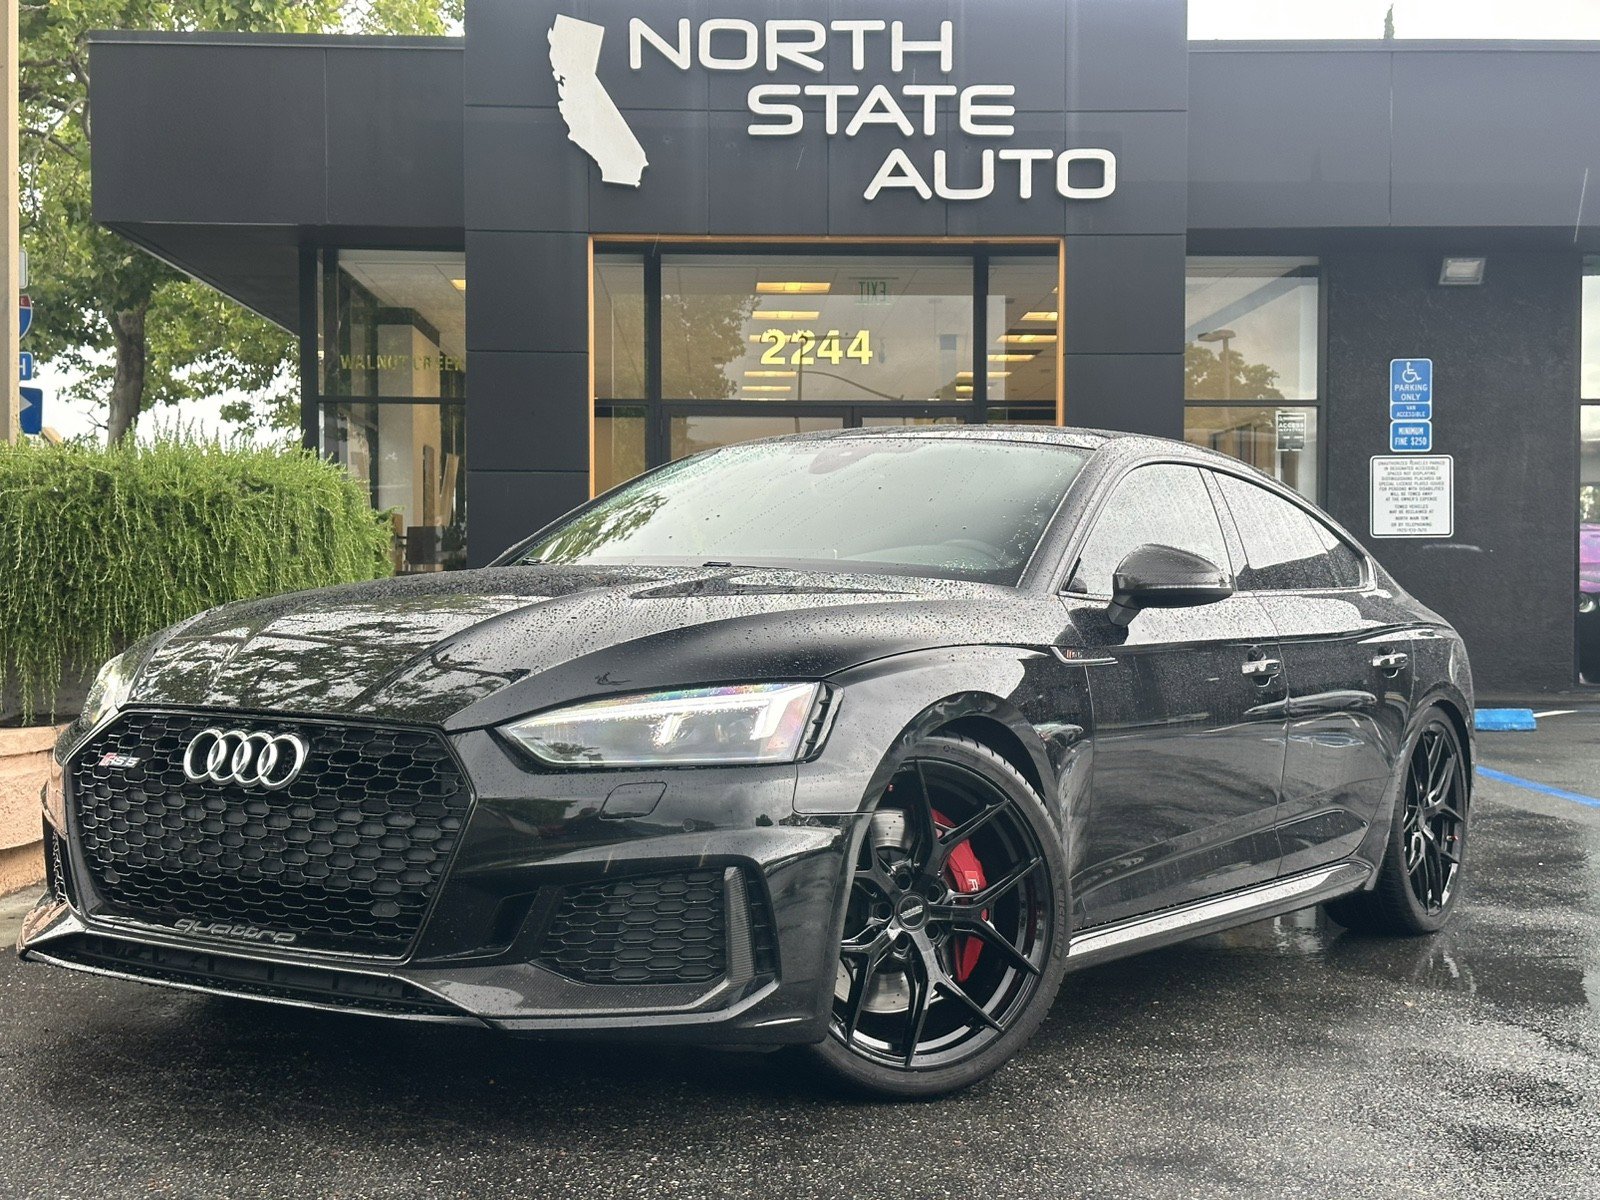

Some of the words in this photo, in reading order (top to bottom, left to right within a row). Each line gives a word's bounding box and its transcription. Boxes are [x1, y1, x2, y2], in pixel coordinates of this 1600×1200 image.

[628, 17, 954, 73] NORTH
[747, 84, 1016, 137] STATE
[863, 147, 1117, 201] AUTO
[759, 327, 873, 366] 2244
[340, 354, 408, 370] WALNUT
[1394, 384, 1428, 392] PARKING
[1400, 393, 1421, 401] ONLY
[1394, 437, 1408, 446] FINE
[1410, 436, 1427, 446] $250
[1398, 427, 1424, 435] MINIMUM
[174, 918, 297, 943] quattro
